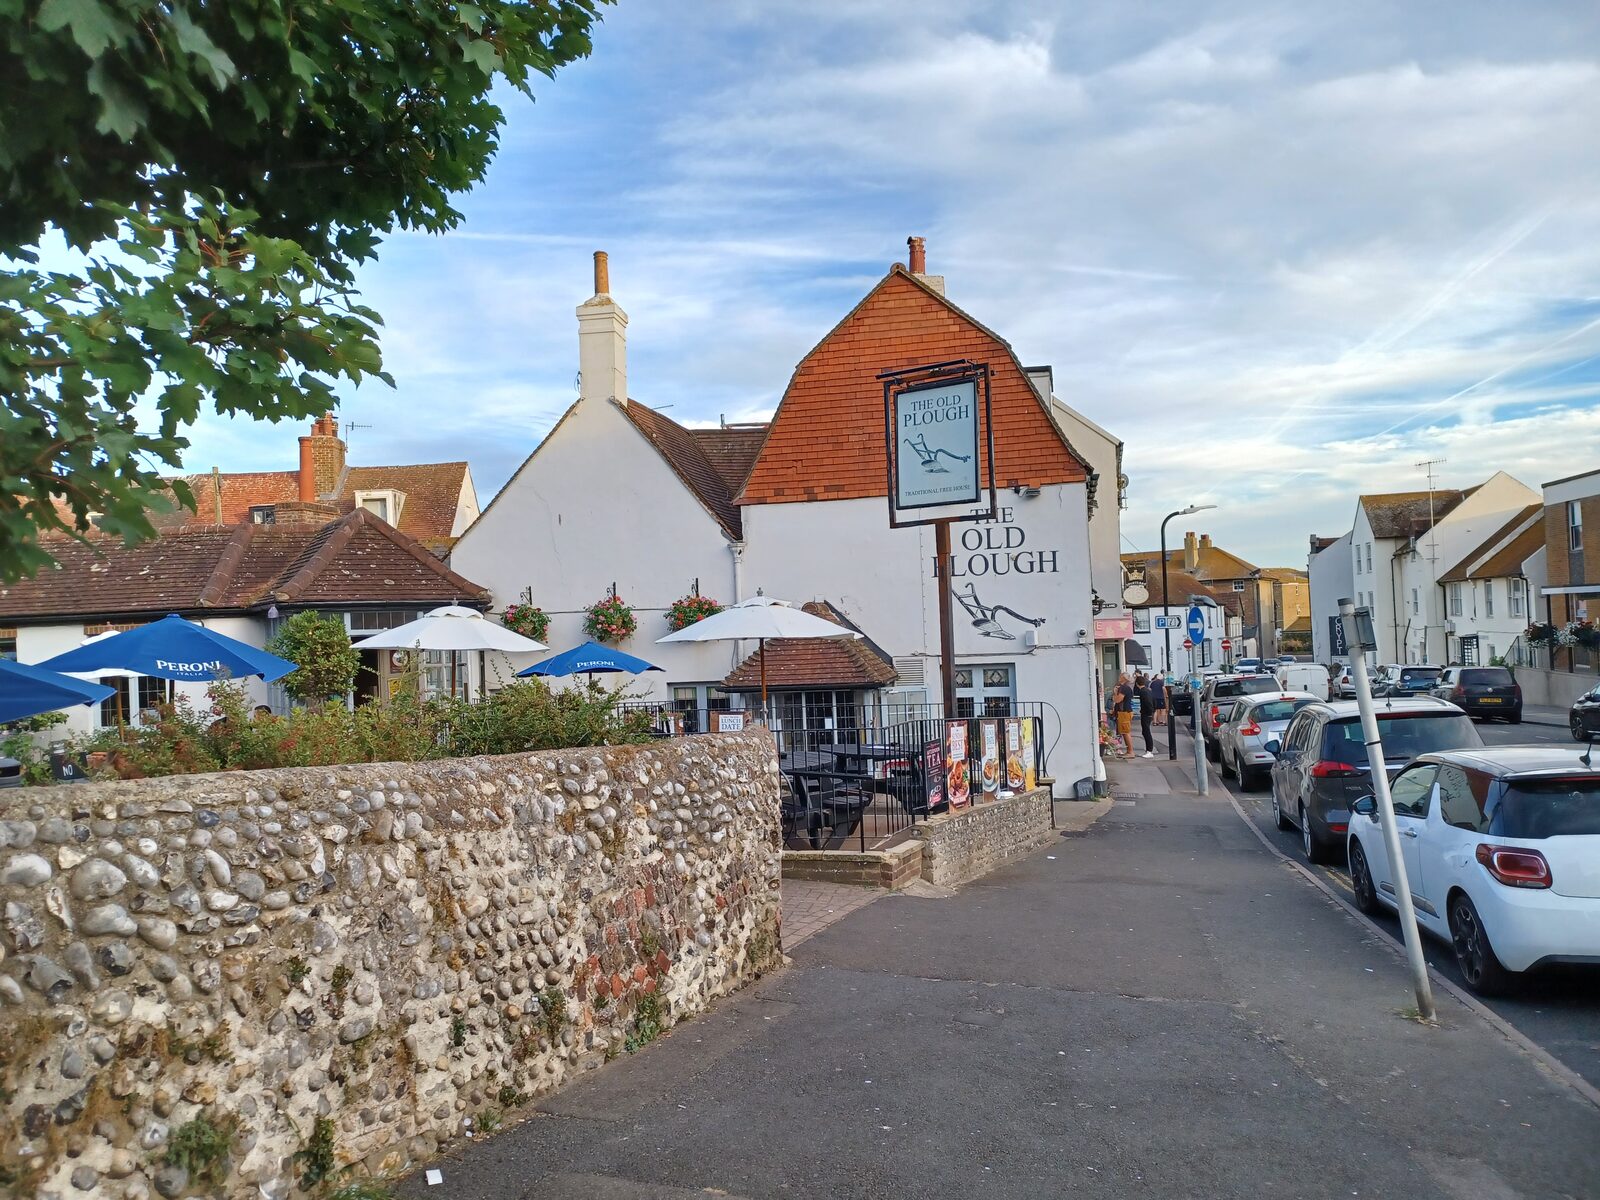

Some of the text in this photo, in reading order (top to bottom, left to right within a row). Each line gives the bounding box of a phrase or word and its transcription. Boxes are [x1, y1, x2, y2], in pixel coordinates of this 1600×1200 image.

[911, 394, 961, 411] THE OLD
[903, 404, 970, 427] PLOUGH
[905, 488, 939, 496] TRADITIONAL
[940, 486, 953, 494] FREE
[961, 526, 1026, 551] OLD
[1159, 618, 1165, 626] P
[1334, 616, 1343, 655] CRYPT
[156, 659, 220, 672] PERONI
[576, 660, 615, 668] PERONI
[926, 752, 941, 768] TEA
[62, 764, 73, 777] NO
